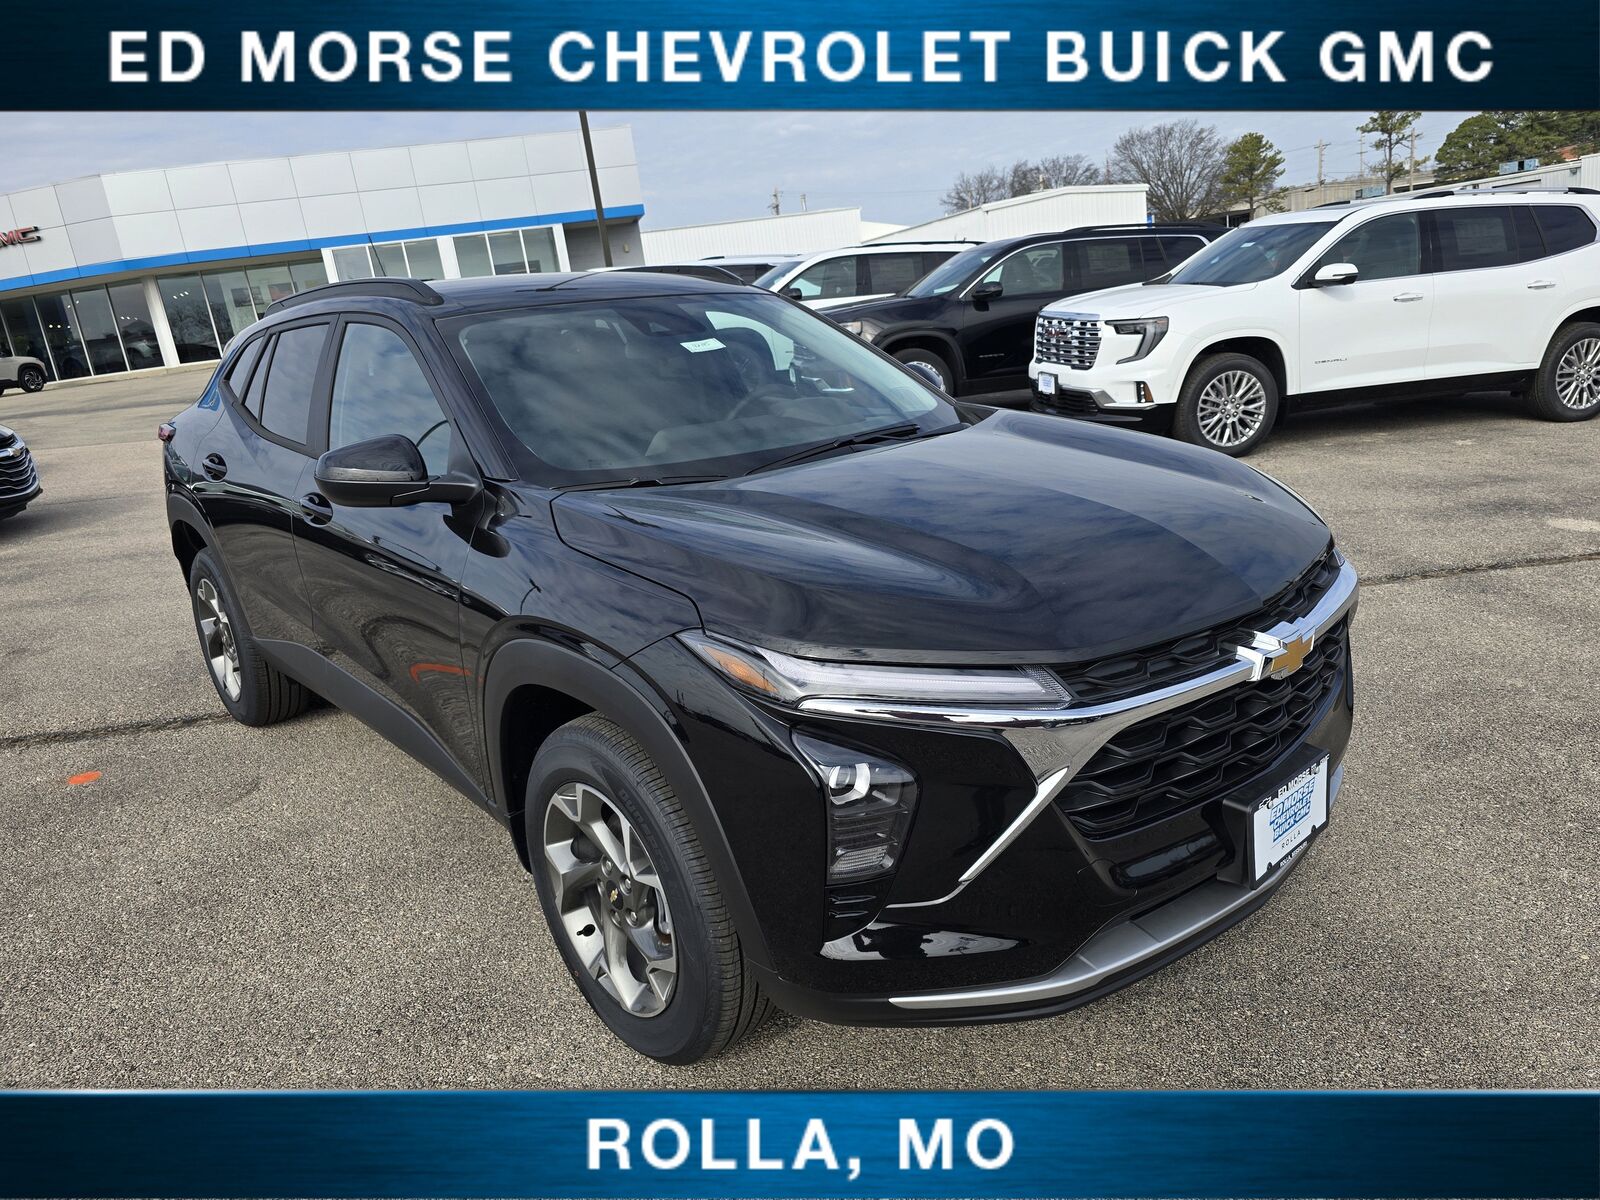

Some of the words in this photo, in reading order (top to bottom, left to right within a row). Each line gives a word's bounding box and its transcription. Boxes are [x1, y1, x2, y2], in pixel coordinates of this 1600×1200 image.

[0, 226, 41, 248] MC
[1284, 780, 1314, 811] MORSE
[1281, 830, 1301, 849] ROLLA
